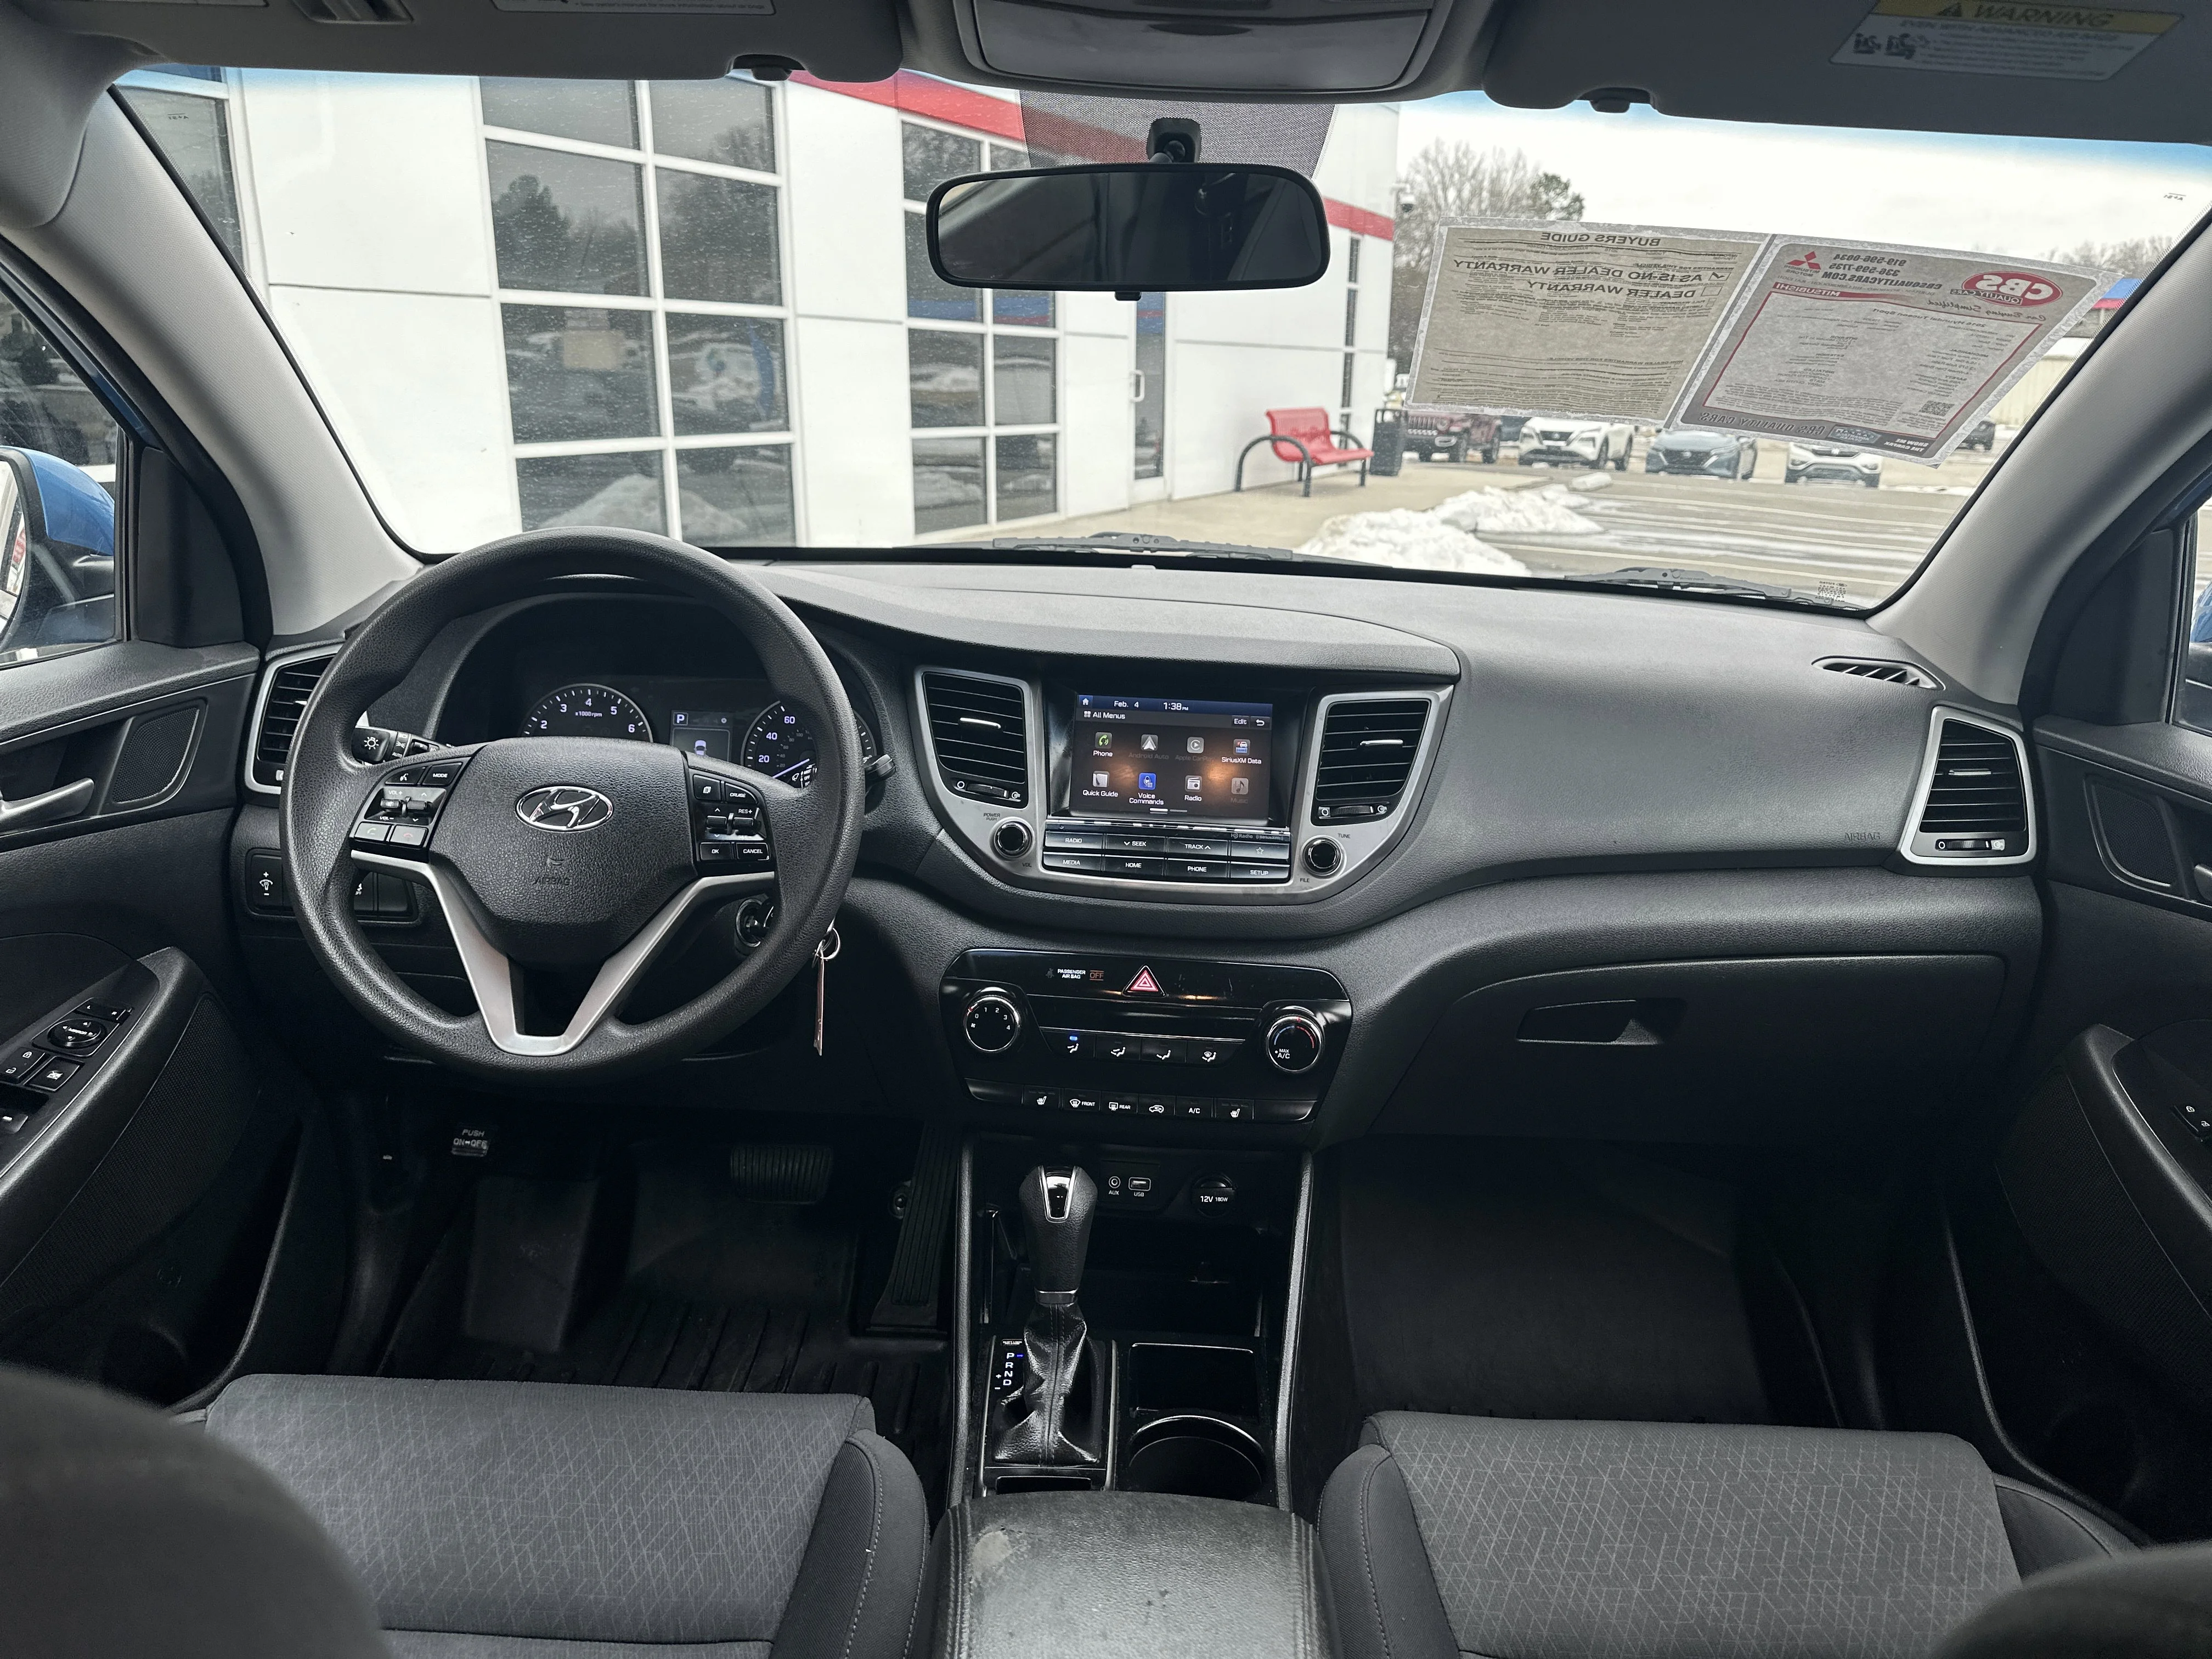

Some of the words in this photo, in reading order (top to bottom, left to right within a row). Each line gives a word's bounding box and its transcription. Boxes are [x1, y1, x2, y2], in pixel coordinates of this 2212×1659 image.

[1974, 4, 2114, 27] WARNING
[585, 698, 592, 707] 4
[1163, 702, 1182, 710] 1:38
[560, 703, 567, 713] 3
[610, 706, 617, 715] 5
[676, 714, 685, 723] P
[784, 716, 795, 724] 60
[540, 720, 548, 729] 2
[628, 724, 635, 733] 6
[758, 755, 770, 763] 20
[1844, 832, 1881, 843] AIRBAG
